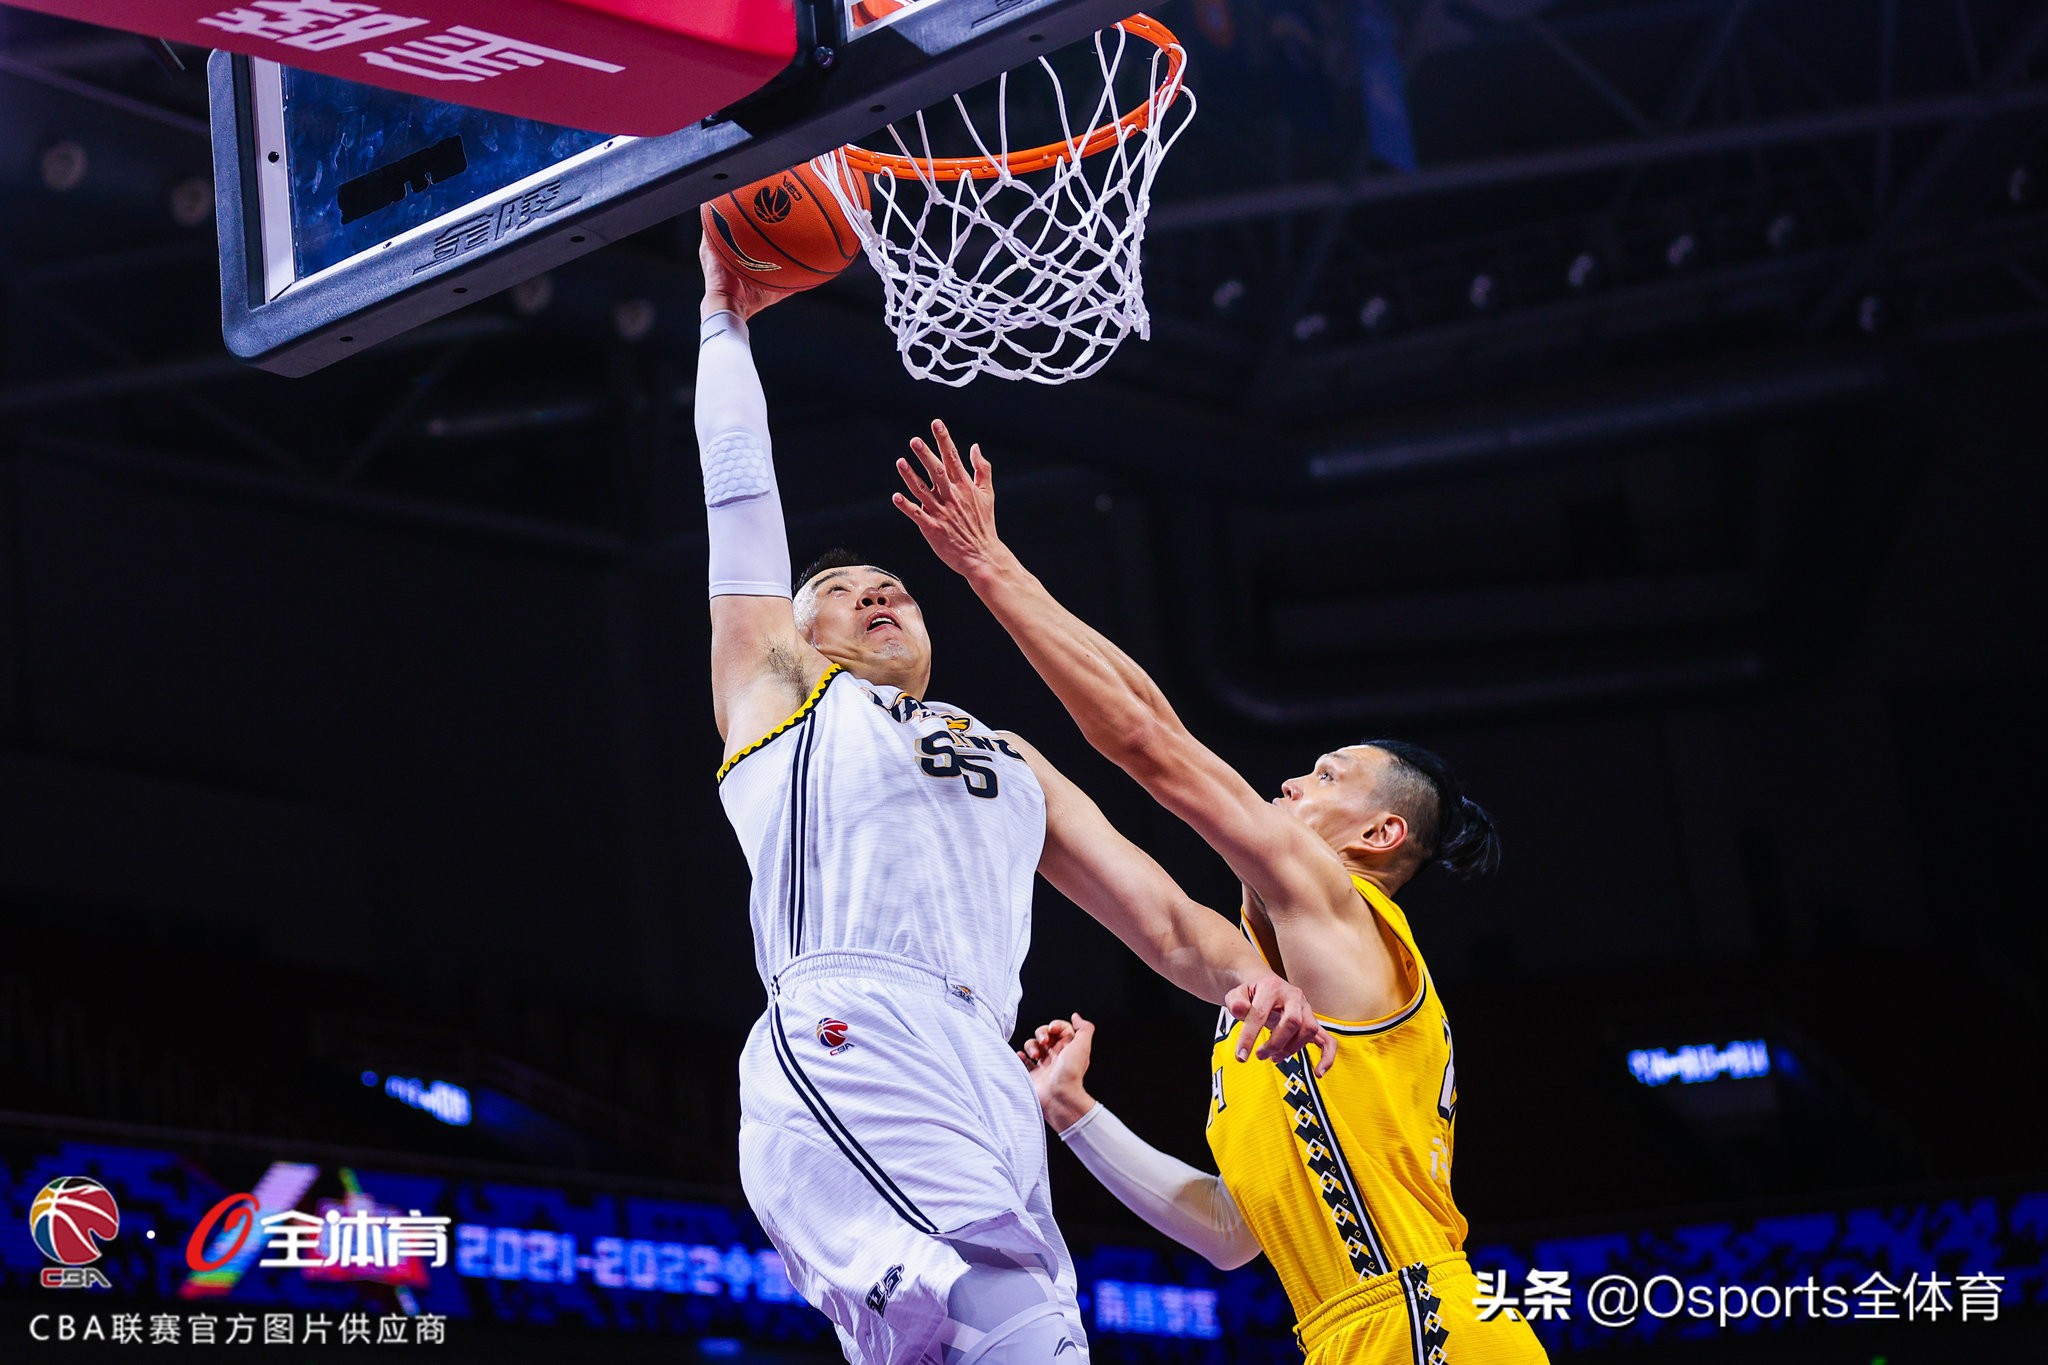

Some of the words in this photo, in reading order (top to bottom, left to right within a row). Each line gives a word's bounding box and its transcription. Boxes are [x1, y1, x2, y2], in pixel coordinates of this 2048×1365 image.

[782, 174, 803, 202] CBA
[914, 730, 999, 799] 55
[829, 1042, 856, 1056] CBA
